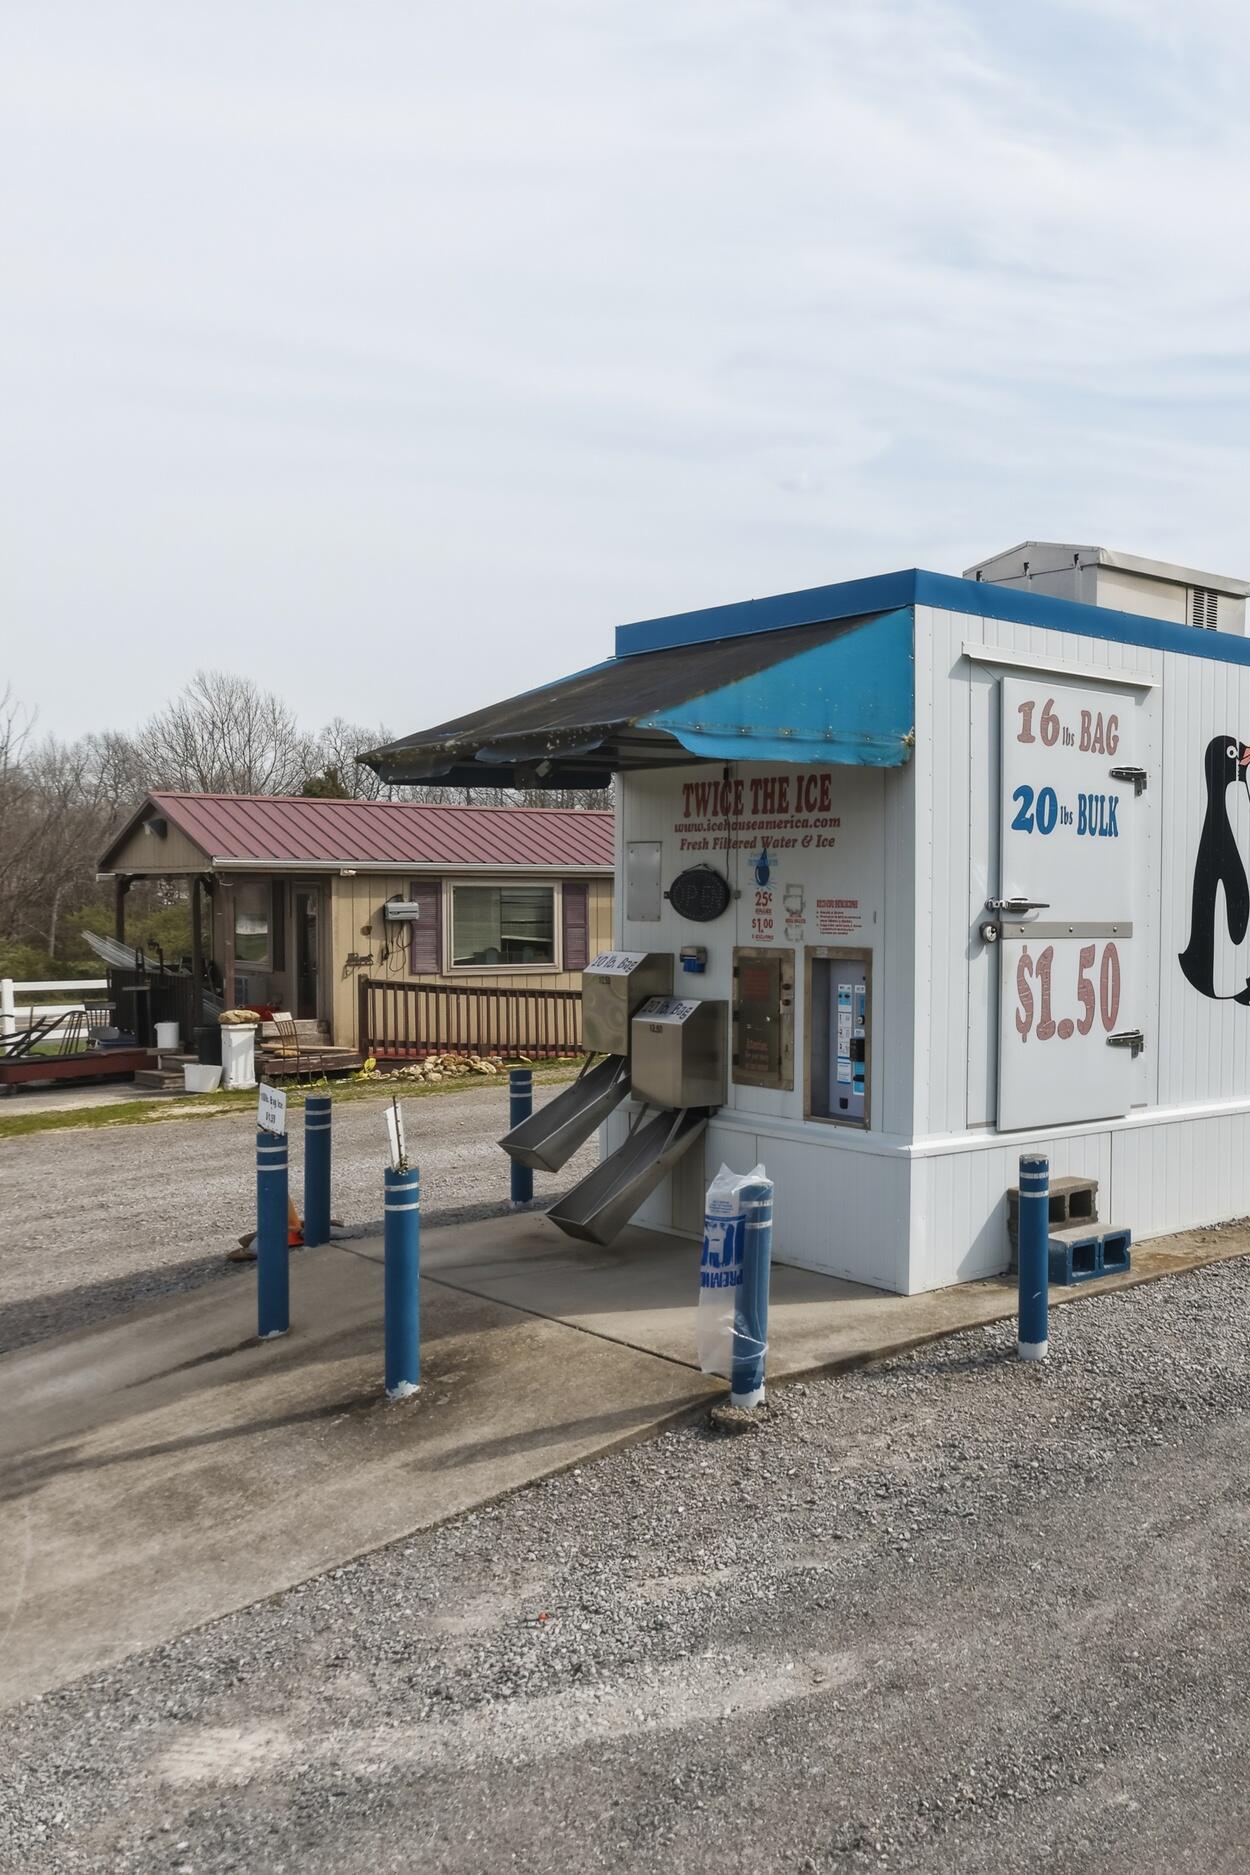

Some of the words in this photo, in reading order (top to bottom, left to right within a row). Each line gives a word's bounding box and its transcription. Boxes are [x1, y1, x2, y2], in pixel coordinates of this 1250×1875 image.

[1017, 698, 1060, 747] 16
[1062, 727, 1075, 747] lbs
[1079, 710, 1119, 756] BAG
[683, 780, 744, 818] TWICE
[750, 776, 790, 815] THE
[795, 773, 832, 813] ICE
[1011, 784, 1058, 835] 20
[1060, 806, 1073, 825] lbs
[1077, 793, 1119, 837] BULK
[680, 838, 709, 851] Fresh
[711, 836, 757, 850] Filtered
[760, 835, 798, 849] Water
[802, 834, 813, 848] &
[815, 834, 835, 848] Ice
[755, 891, 772, 907] 25¢
[617, 957, 638, 973] Bag
[1015, 940, 1121, 1043] $1.50
